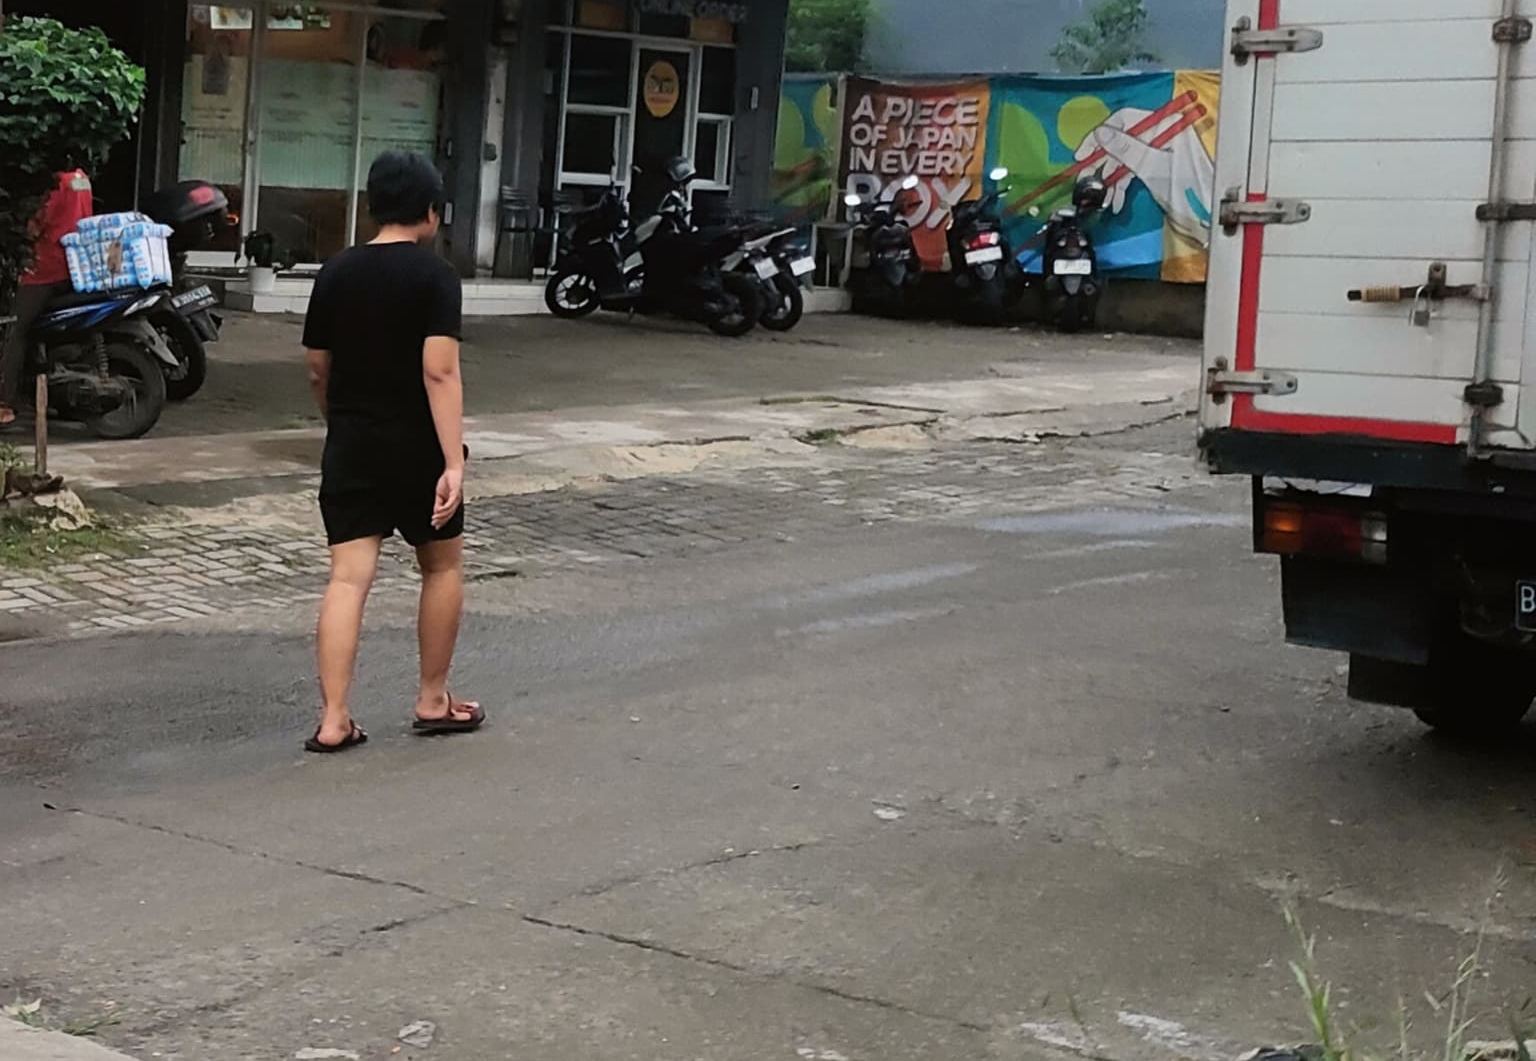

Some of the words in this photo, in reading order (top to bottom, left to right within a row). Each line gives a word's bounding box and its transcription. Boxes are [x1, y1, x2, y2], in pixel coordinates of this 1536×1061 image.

[852, 94, 876, 122] A
[882, 97, 980, 126] PIECE
[850, 123, 888, 147] OF
[892, 125, 978, 150] JAPAN
[849, 146, 876, 172] IN
[880, 149, 975, 175] EVERY
